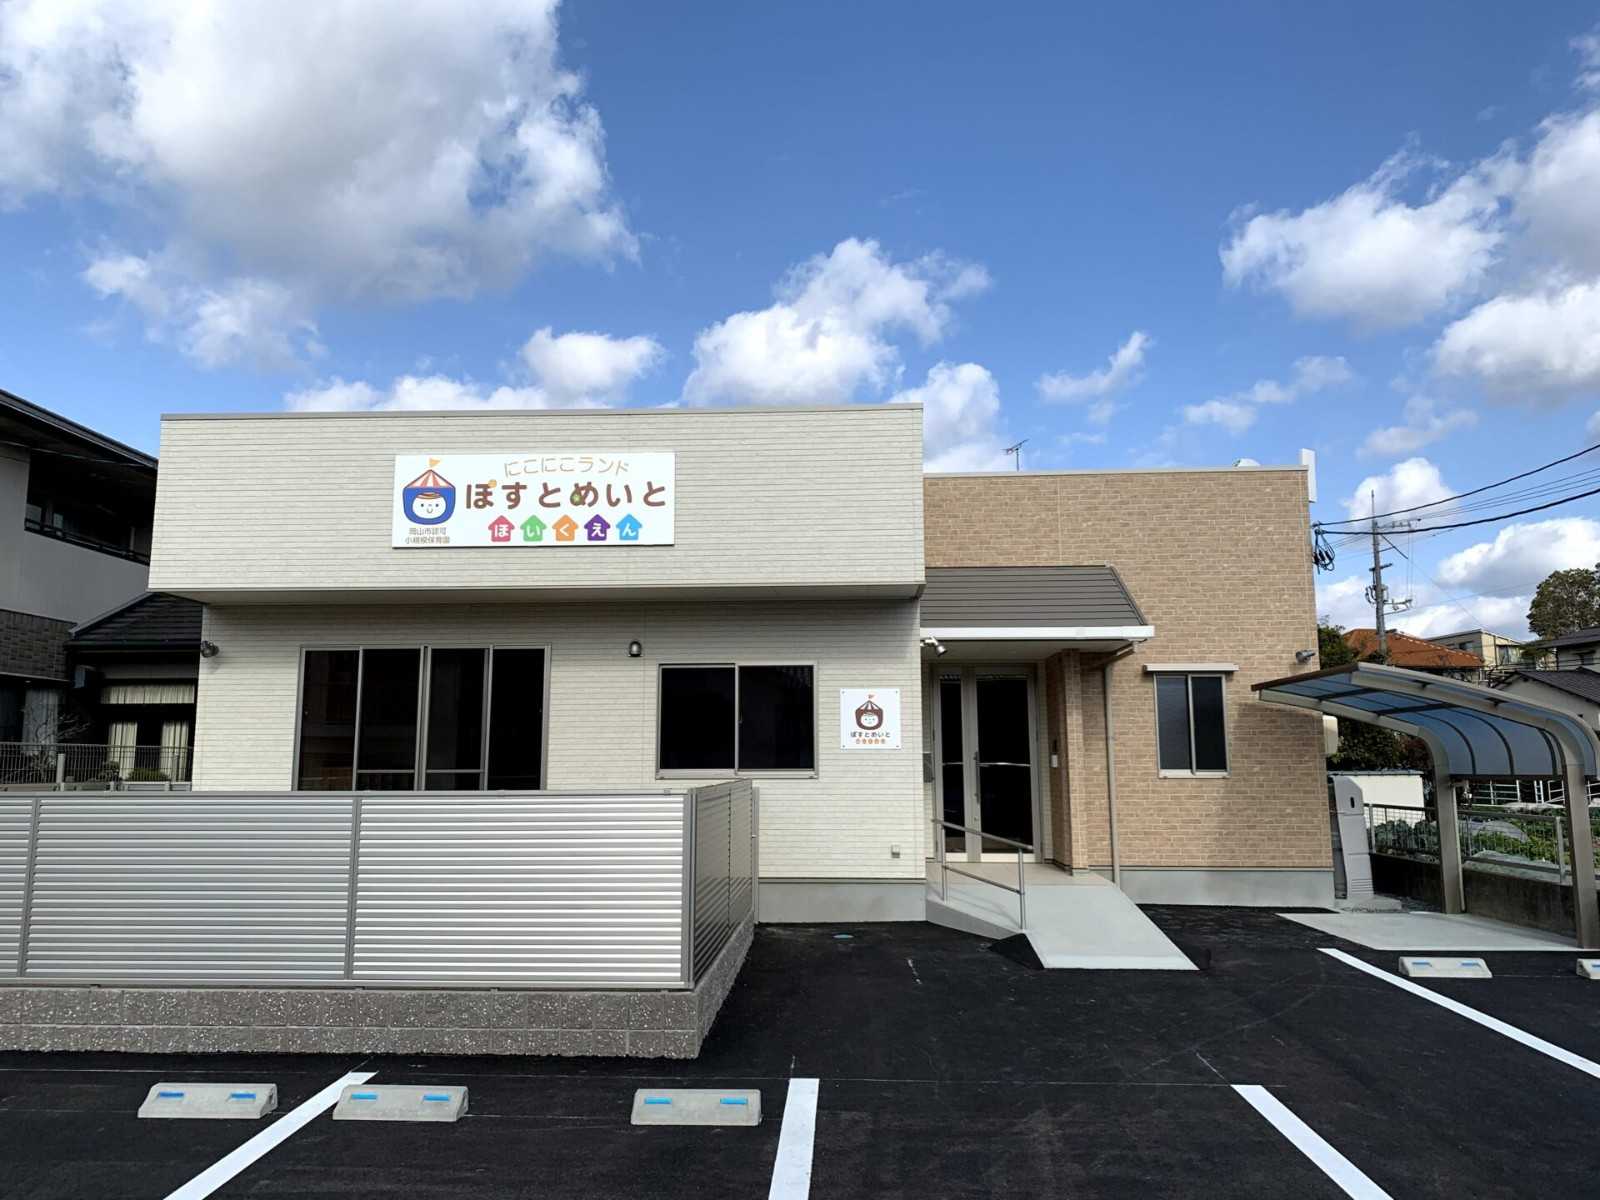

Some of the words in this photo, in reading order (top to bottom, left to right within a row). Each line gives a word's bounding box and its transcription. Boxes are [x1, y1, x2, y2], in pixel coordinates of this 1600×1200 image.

[504, 457, 629, 476] にこにこランド
[466, 480, 666, 510] ぽすとめいと
[492, 522, 638, 539] ほいくえん
